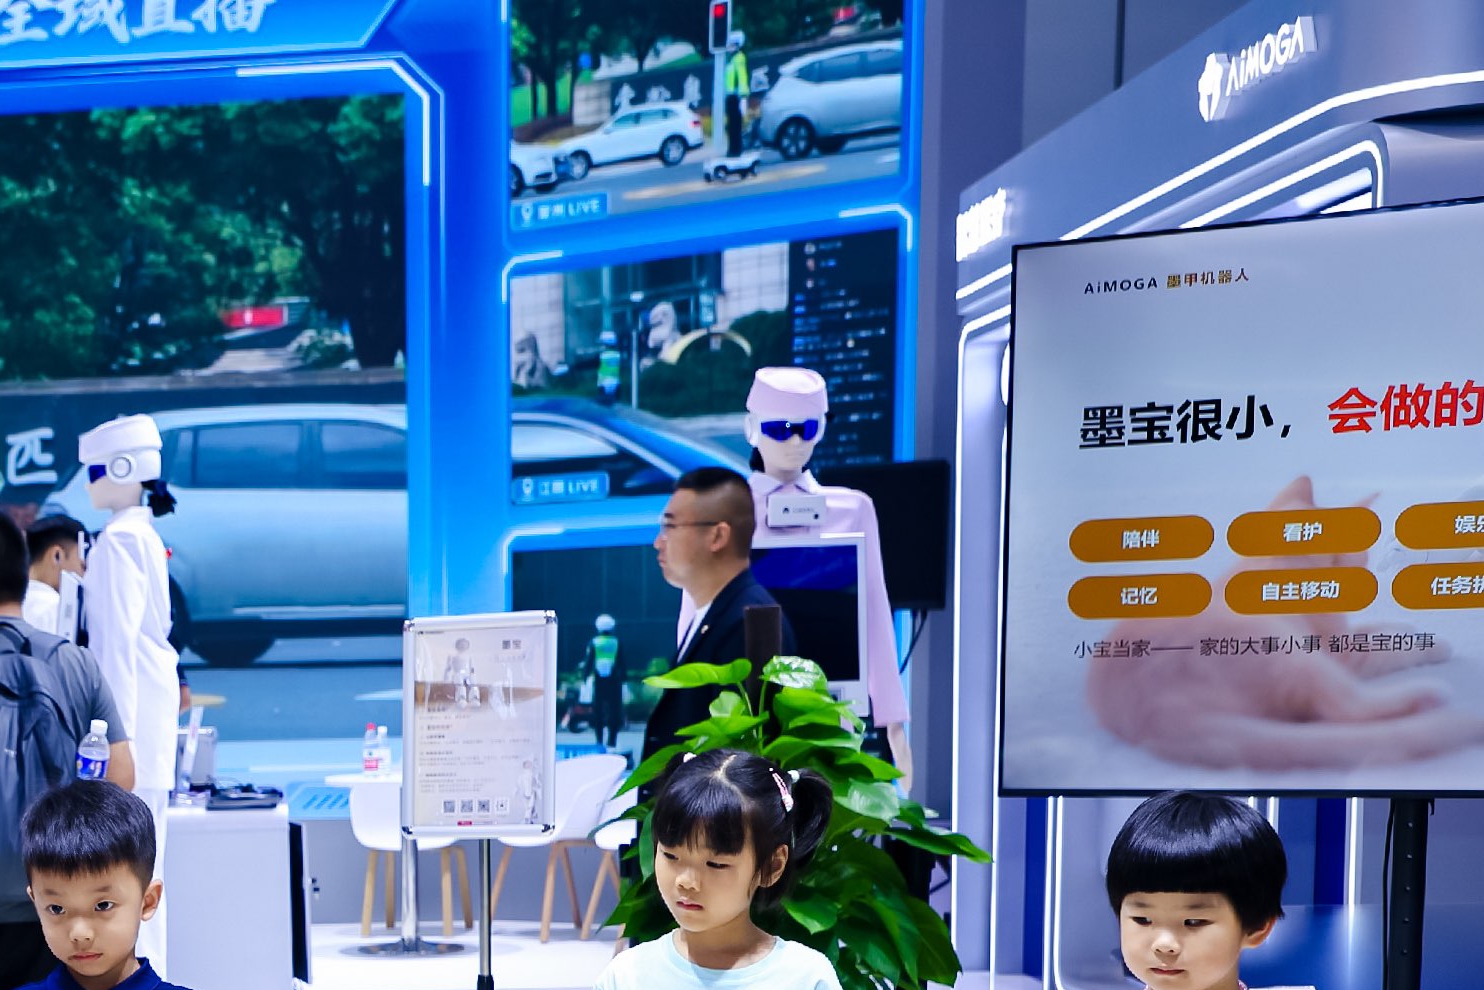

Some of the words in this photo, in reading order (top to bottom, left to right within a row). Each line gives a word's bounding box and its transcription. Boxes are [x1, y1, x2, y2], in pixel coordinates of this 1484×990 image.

[1226, 15, 1304, 97] AiMOGA
[1083, 277, 1158, 294] AiMOGA
[1166, 267, 1250, 289] 墨甲机器人
[1327, 380, 1484, 434] 会做的
[1122, 529, 1160, 550] 陪伴
[1283, 521, 1323, 543] 看护
[1120, 586, 1158, 606] 记忆
[1261, 580, 1340, 602] 自主移动
[1199, 635, 1321, 656] 家的大事小事
[1328, 631, 1436, 654] 都是宝的事
